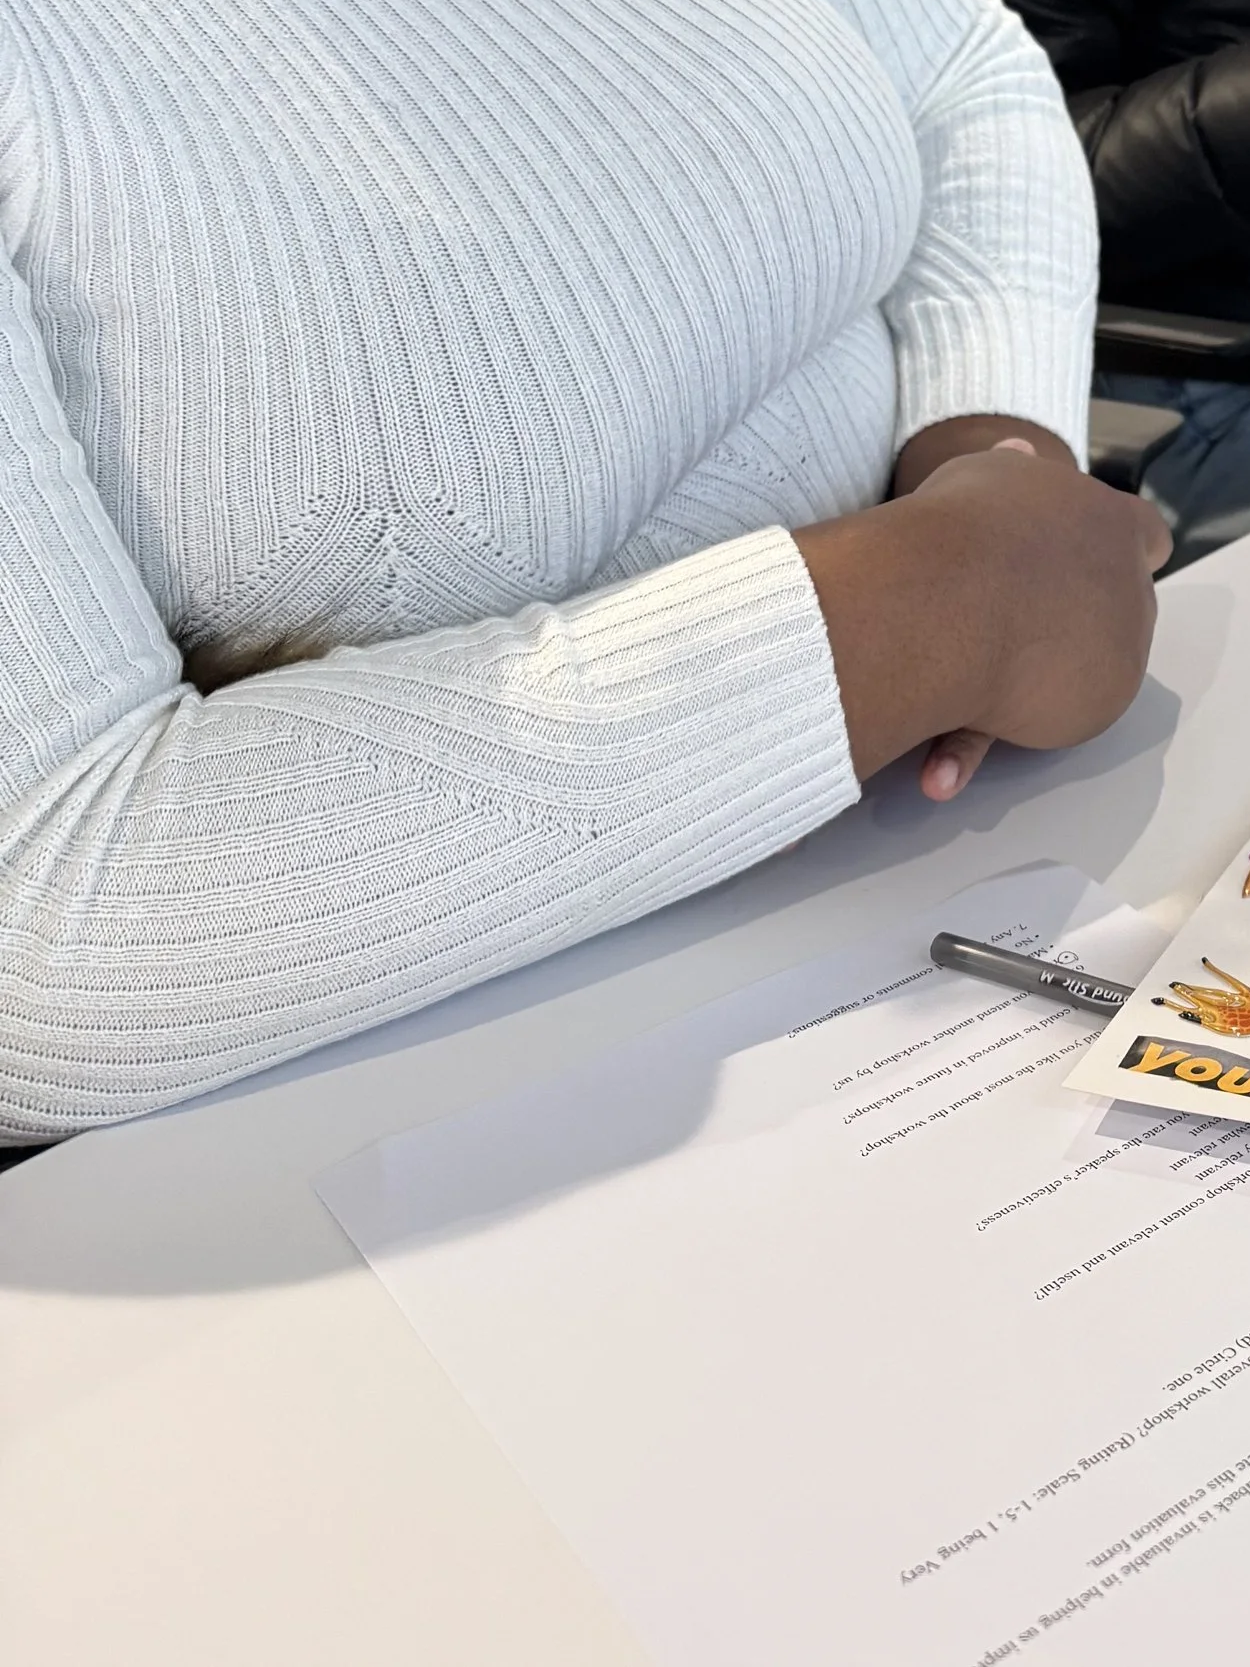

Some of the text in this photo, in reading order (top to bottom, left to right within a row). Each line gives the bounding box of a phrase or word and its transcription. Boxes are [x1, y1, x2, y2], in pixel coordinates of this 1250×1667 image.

[990, 923, 1028, 944] 7. Any
[1014, 938, 1034, 949] No
[1039, 969, 1055, 985] M
[787, 968, 933, 1038] comments or suggestions?
[833, 989, 1034, 1092] you attend another workshop by us?
[1058, 1039, 1084, 1058] you
[842, 1009, 1071, 1124] could be improved in future workshops?
[1012, 1064, 1036, 1077] the
[1035, 1053, 1062, 1067] like
[983, 1073, 1016, 1094] most
[947, 1088, 984, 1111] about
[928, 1109, 951, 1121] the
[860, 1119, 927, 1157] workshop?
[976, 1111, 1190, 1231] you rate the speaker's effectiveness?
[1169, 1142, 1218, 1171] relevant
[1194, 1150, 1245, 1181] relevant
[1158, 1196, 1206, 1226] content
[1106, 1222, 1160, 1256] relevant
[1079, 1254, 1107, 1273] and
[1034, 1263, 1084, 1300] useful?
[1193, 1347, 1237, 1374] Circle
[1162, 1373, 1193, 1391] one.
[1136, 1387, 1213, 1438] workshop?
[1077, 1432, 1135, 1471] (Rating
[1032, 1468, 1081, 1502] Scale:
[1206, 1469, 1238, 1492] this
[986, 1521, 999, 1533] 1
[1130, 1488, 1207, 1542] evaluation
[1197, 1510, 1217, 1525] is
[937, 1529, 988, 1561] being
[1086, 1539, 1131, 1568] form.
[1120, 1521, 1200, 1576] invaluable
[900, 1560, 941, 1586] Very
[1099, 1573, 1123, 1589] in
[1038, 1586, 1104, 1629] helping
